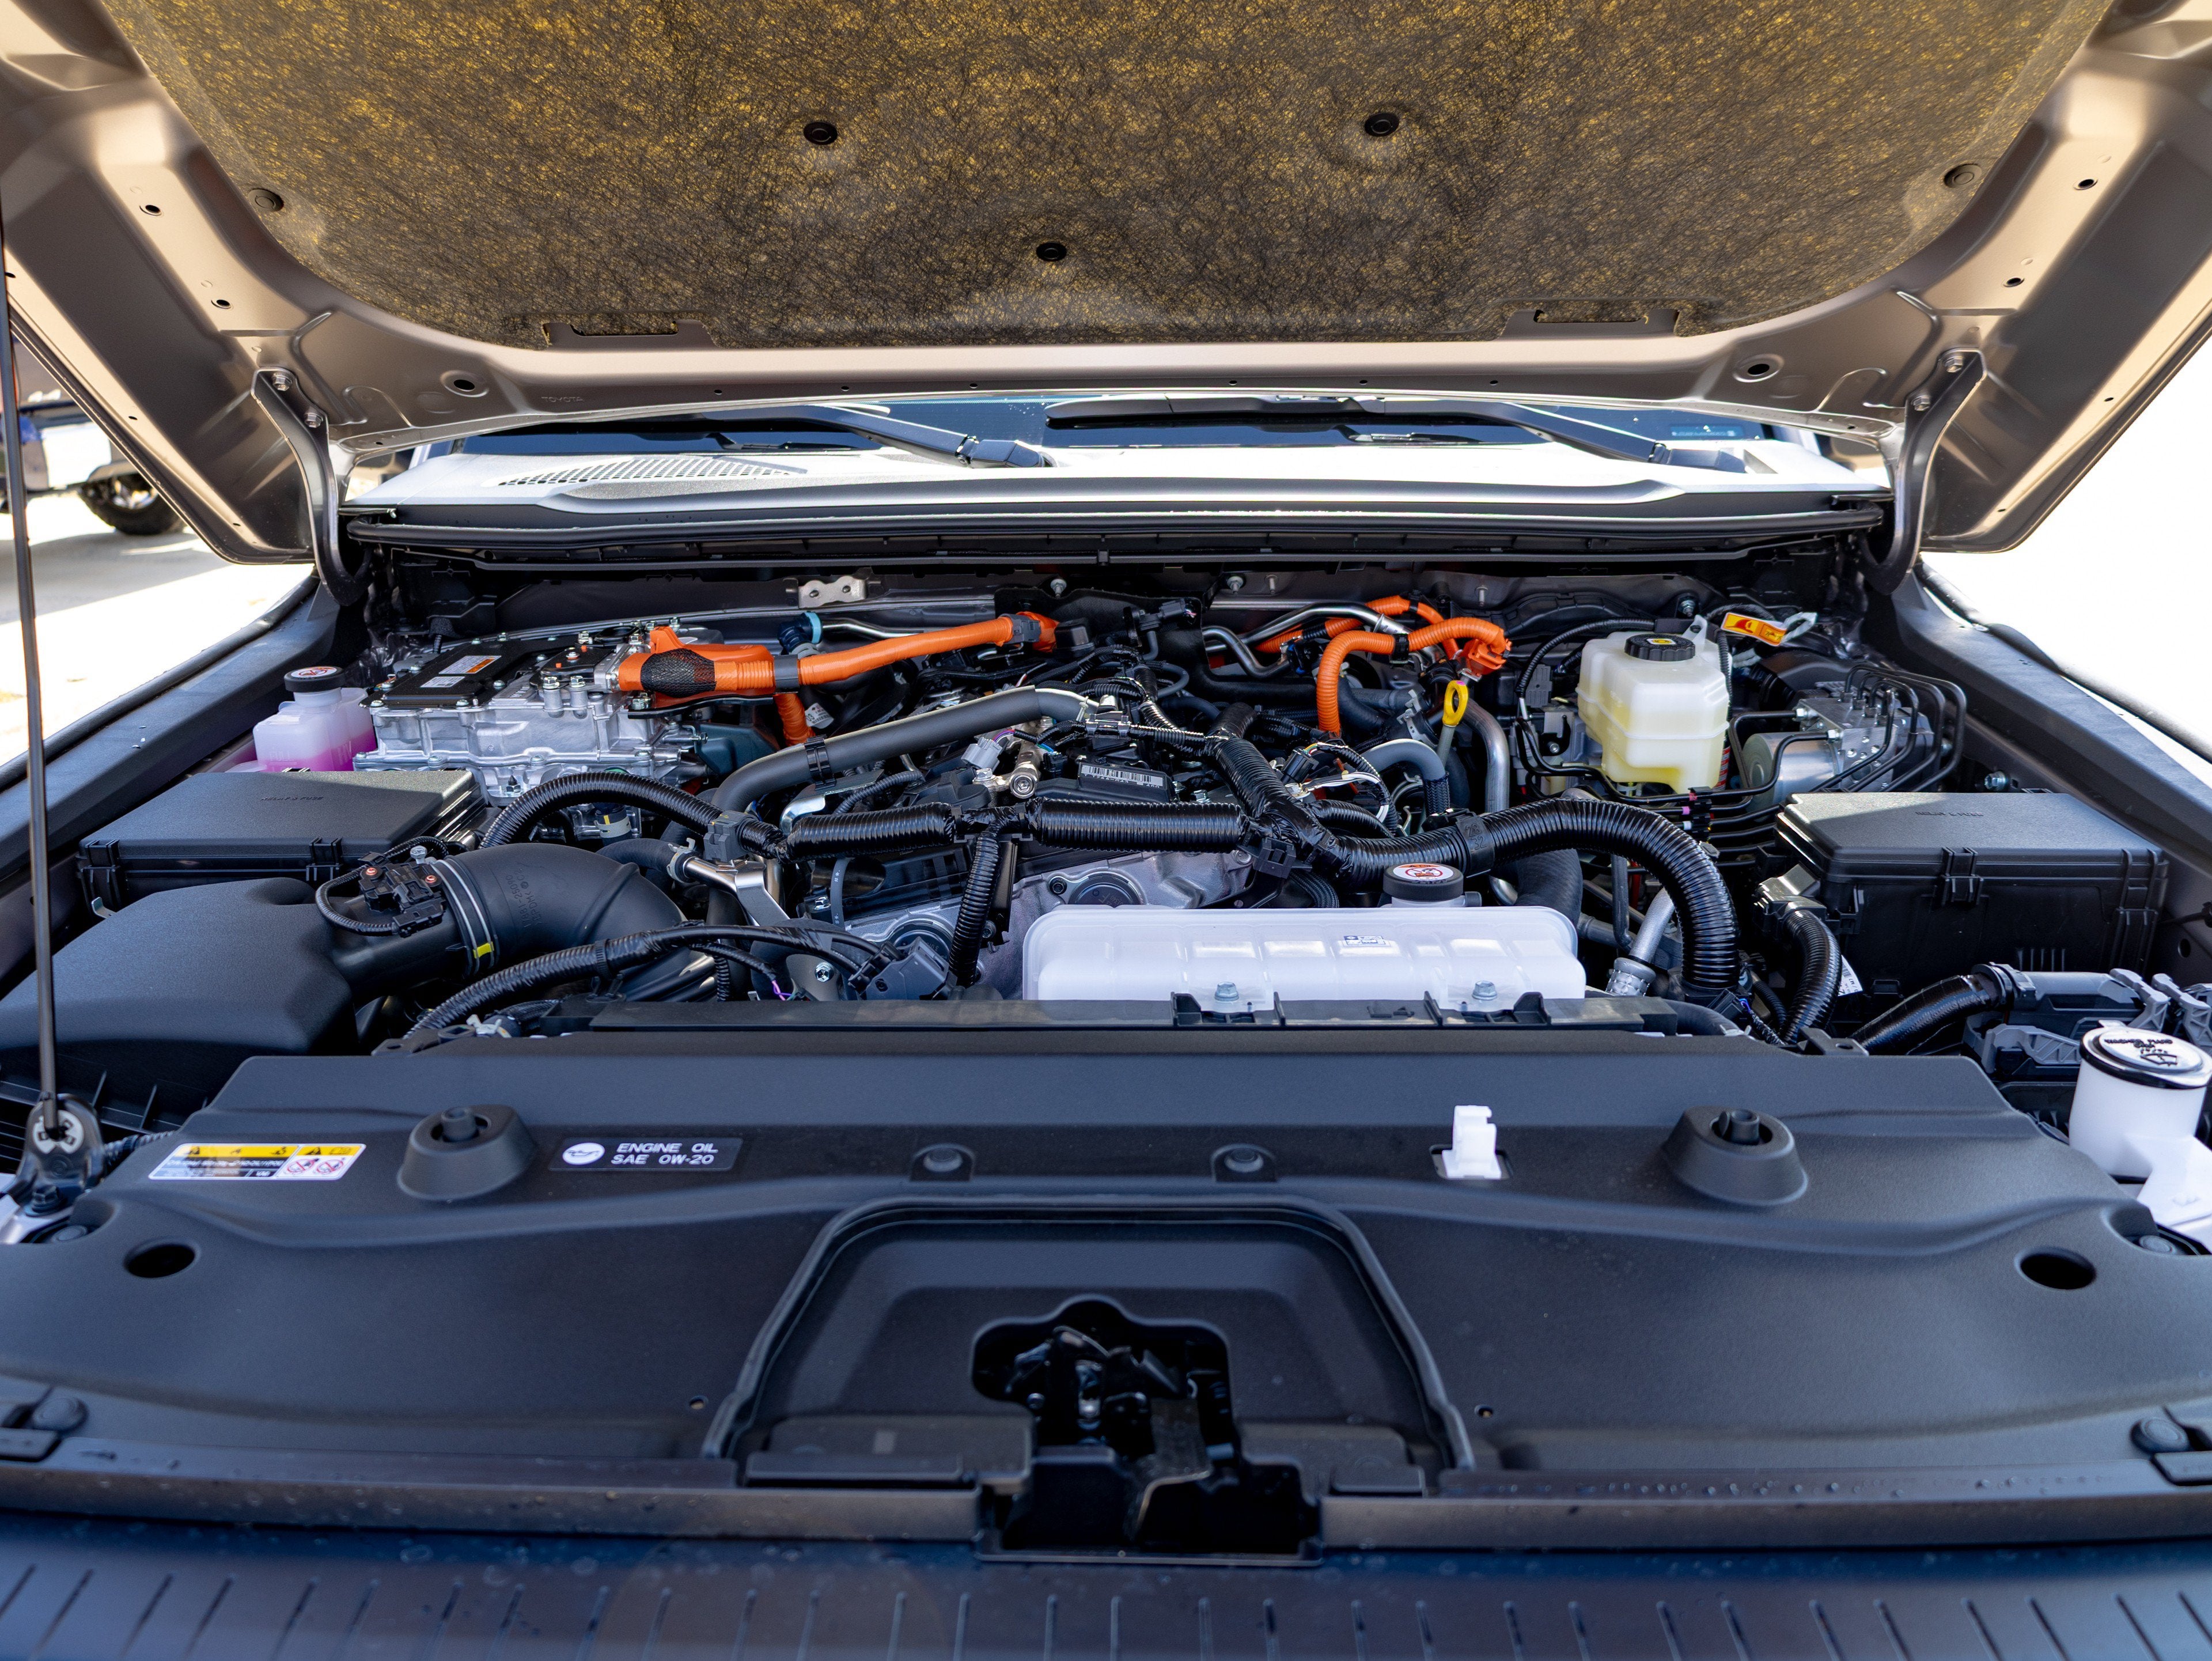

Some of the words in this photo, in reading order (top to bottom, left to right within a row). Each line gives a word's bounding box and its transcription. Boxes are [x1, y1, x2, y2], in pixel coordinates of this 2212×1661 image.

[1470, 835, 1487, 850] 32
[616, 1142, 683, 1153] ENGINE
[691, 1142, 719, 1153] OIL
[611, 1154, 650, 1165] SAE
[658, 1154, 715, 1165] 0W-20
